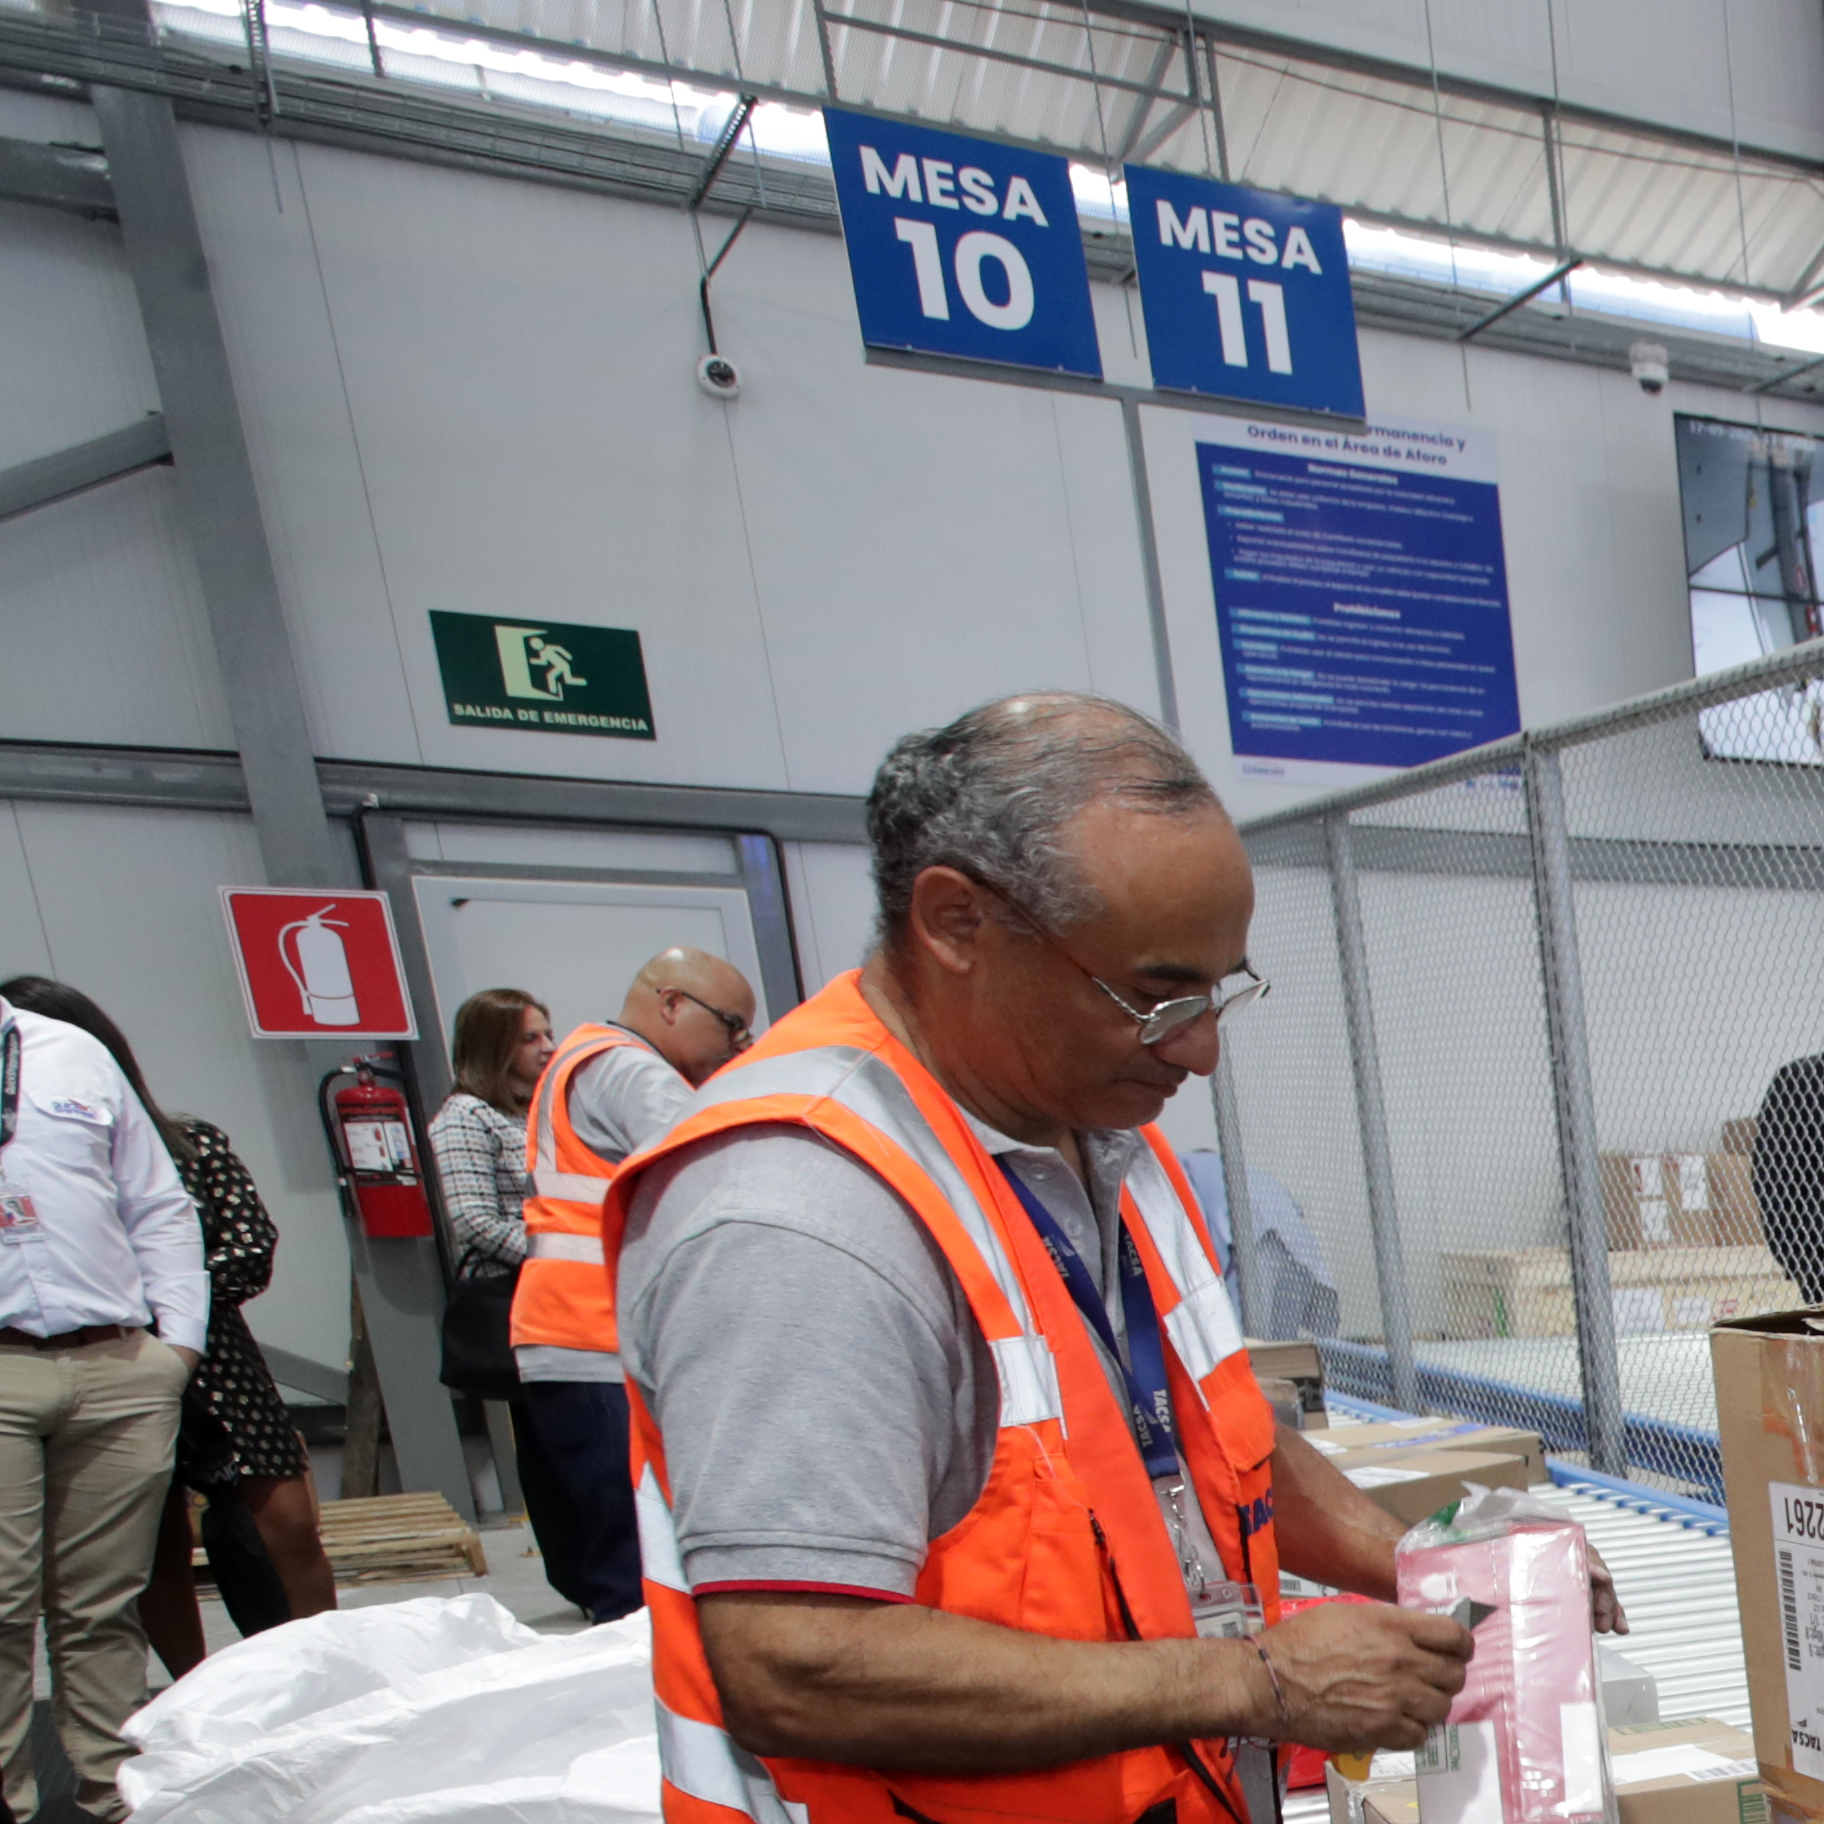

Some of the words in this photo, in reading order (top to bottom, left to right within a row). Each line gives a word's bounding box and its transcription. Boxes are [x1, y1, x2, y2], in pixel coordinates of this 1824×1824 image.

[858, 145, 1049, 228] MESA
[1155, 199, 1322, 275] MESA
[894, 217, 1035, 331] 10
[1200, 270, 1293, 377] 11
[1248, 425, 1297, 444] Orden
[1302, 434, 1321, 446] en
[1326, 434, 1339, 448] el
[1343, 433, 1380, 455] Área
[1383, 445, 1402, 458] de
[1406, 448, 1448, 466] Aforo
[1367, 426, 1453, 448] rmanencia
[1457, 438, 1467, 452] y
[453, 703, 514, 720] SALIDA
[518, 709, 539, 722] DE
[544, 712, 648, 731] EMERGENCIA
[1125, 1232, 1143, 1277] TACSA
[1133, 1404, 1154, 1447] TACSA
[1153, 1389, 1172, 1433] TACSA
[1790, 1729, 1822, 1752] TACSA
